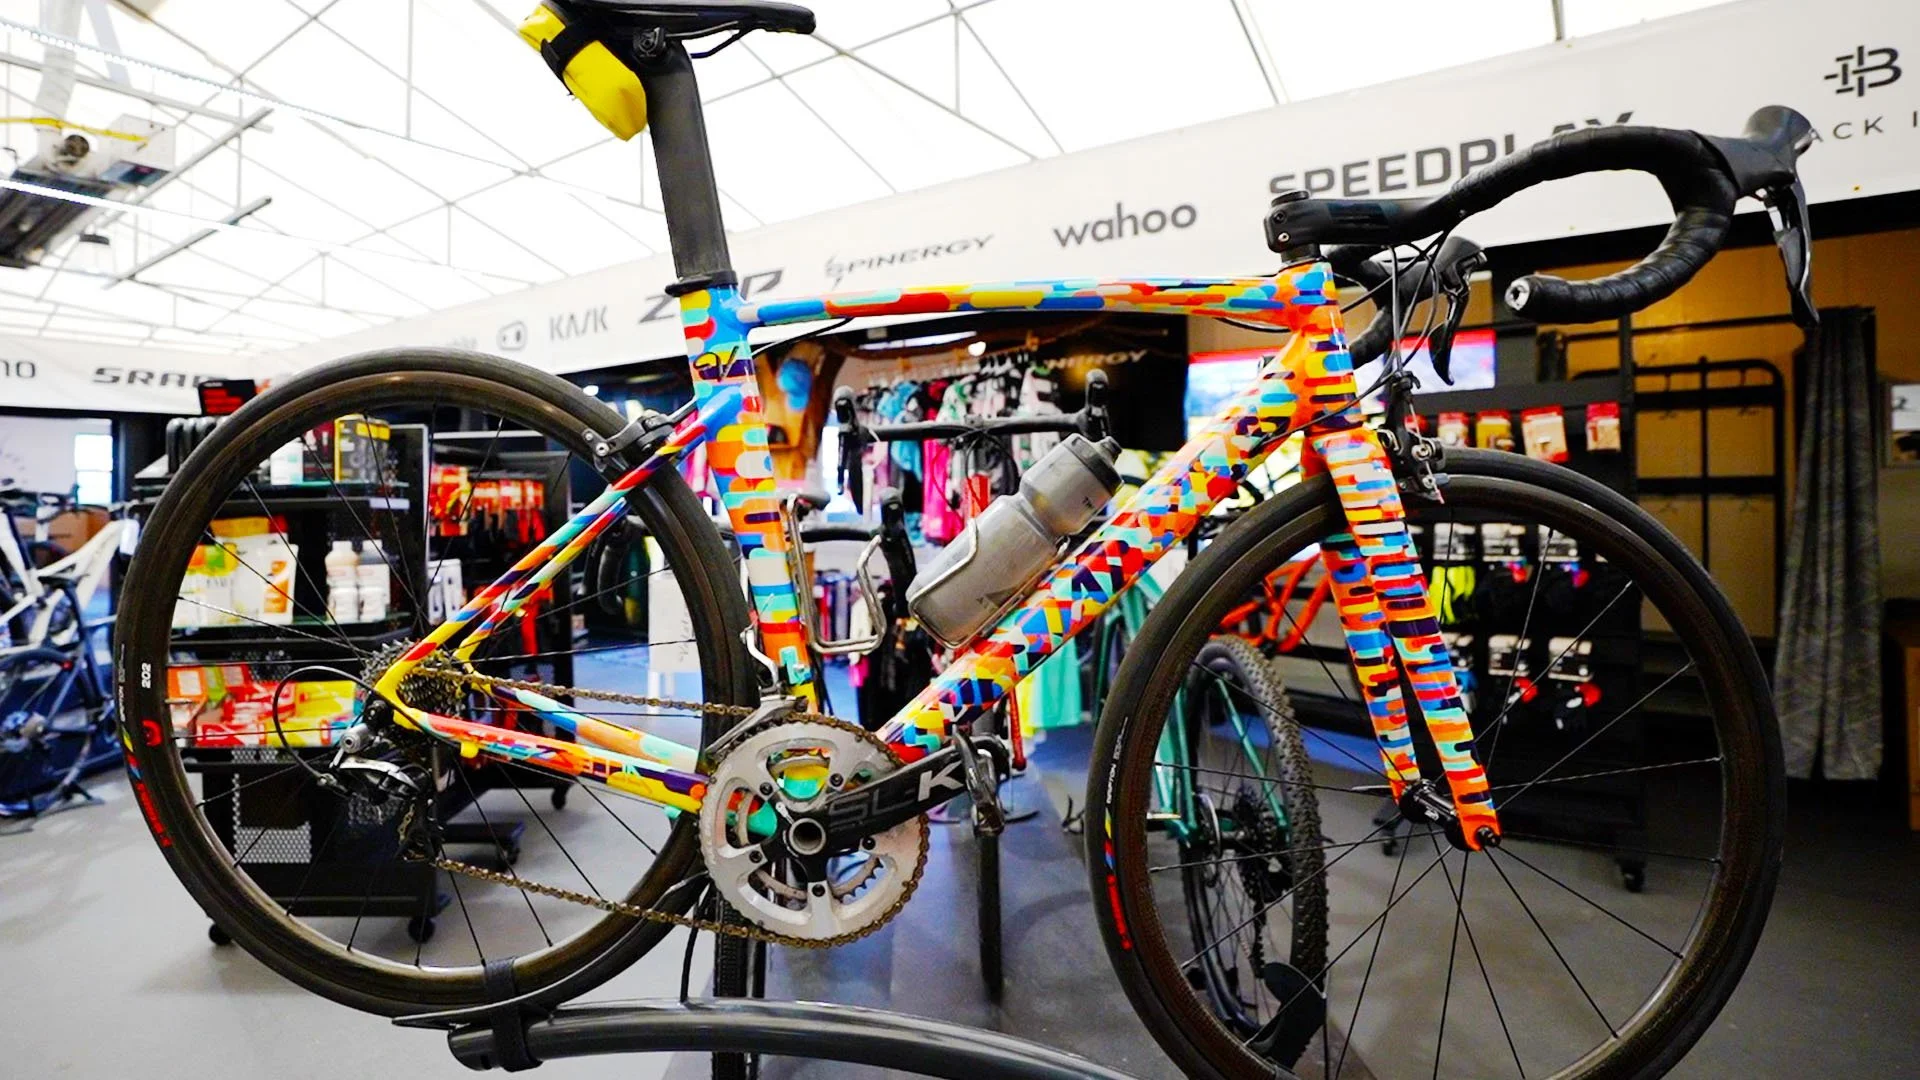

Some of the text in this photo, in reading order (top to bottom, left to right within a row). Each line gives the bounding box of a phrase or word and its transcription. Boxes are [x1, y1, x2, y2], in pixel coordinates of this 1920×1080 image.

[1269, 111, 1634, 198] SPEEDP
[1053, 202, 1197, 248] wahoo
[141, 662, 151, 689] 202
